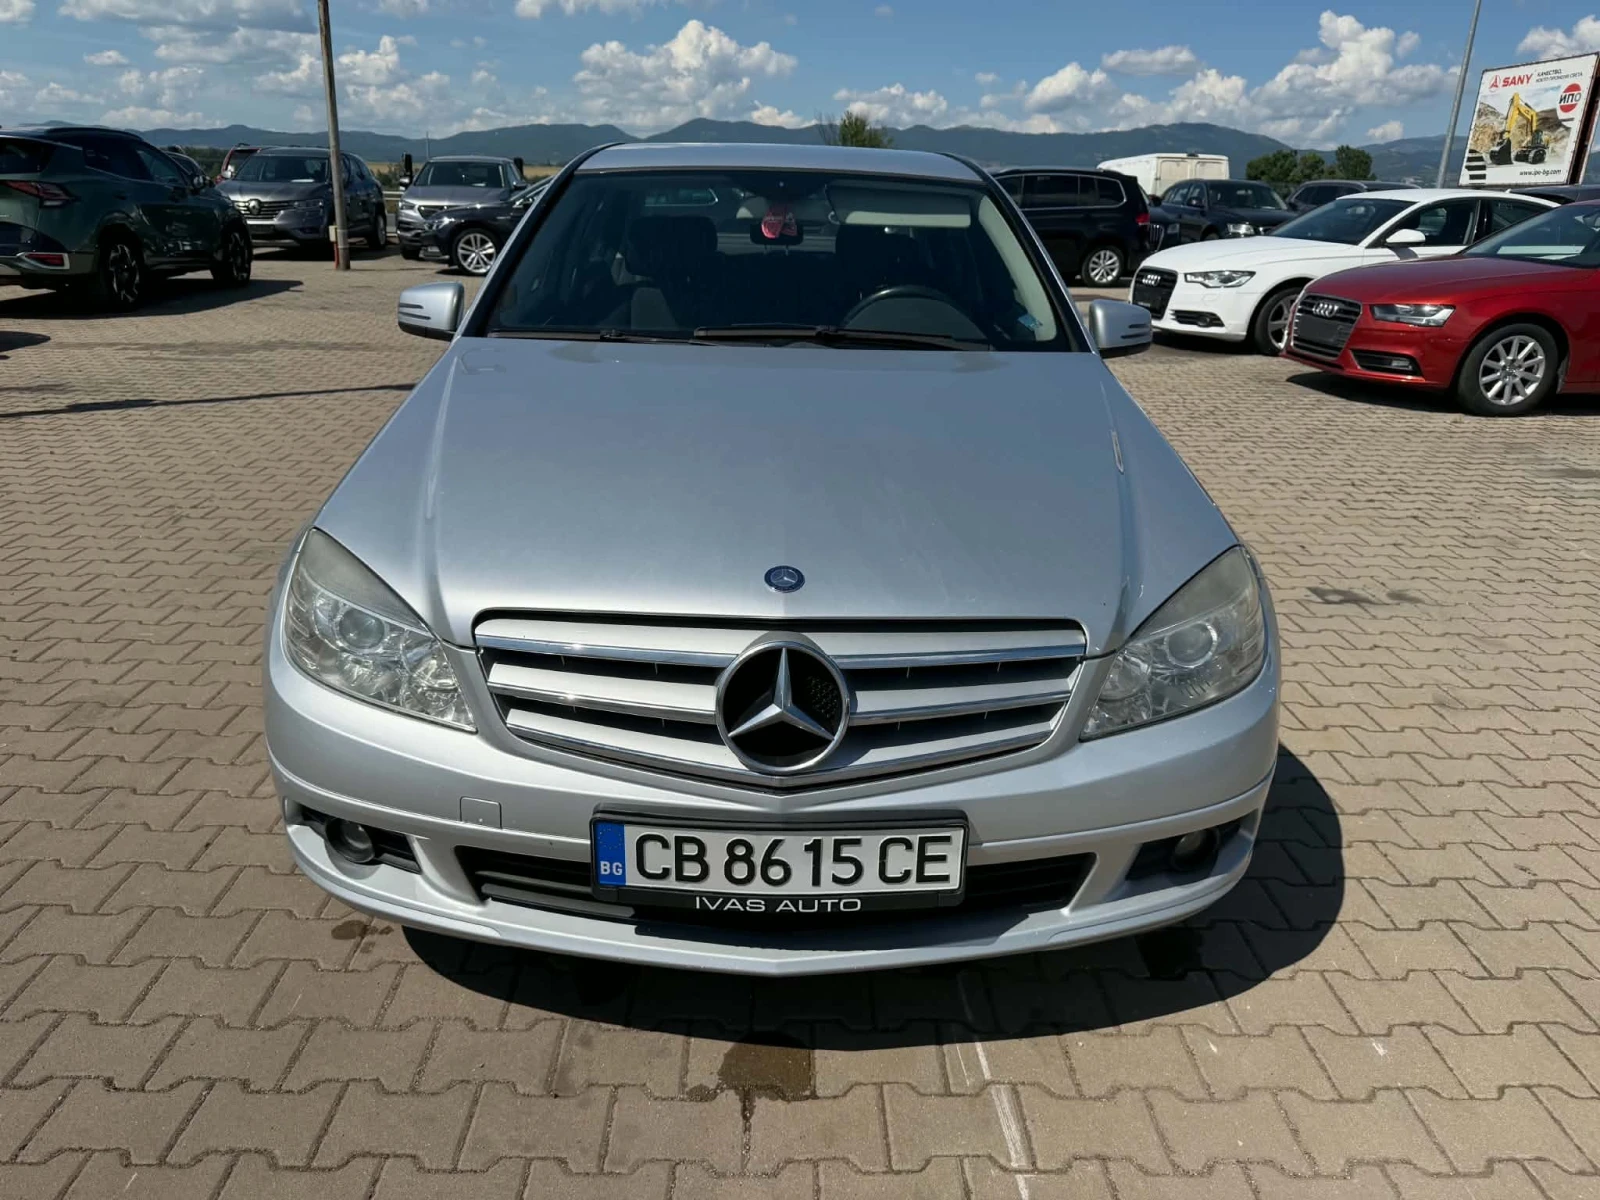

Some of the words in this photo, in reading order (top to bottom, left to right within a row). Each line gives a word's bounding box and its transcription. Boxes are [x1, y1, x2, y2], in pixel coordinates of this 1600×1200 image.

[1502, 74, 1533, 87] SANY
[1559, 93, 1582, 104] ИПО
[635, 833, 708, 883] CB
[723, 838, 863, 887] 8615
[878, 837, 951, 884] CE
[600, 861, 623, 876] BG
[696, 896, 765, 912] IVAS
[776, 899, 861, 912] AUTO
